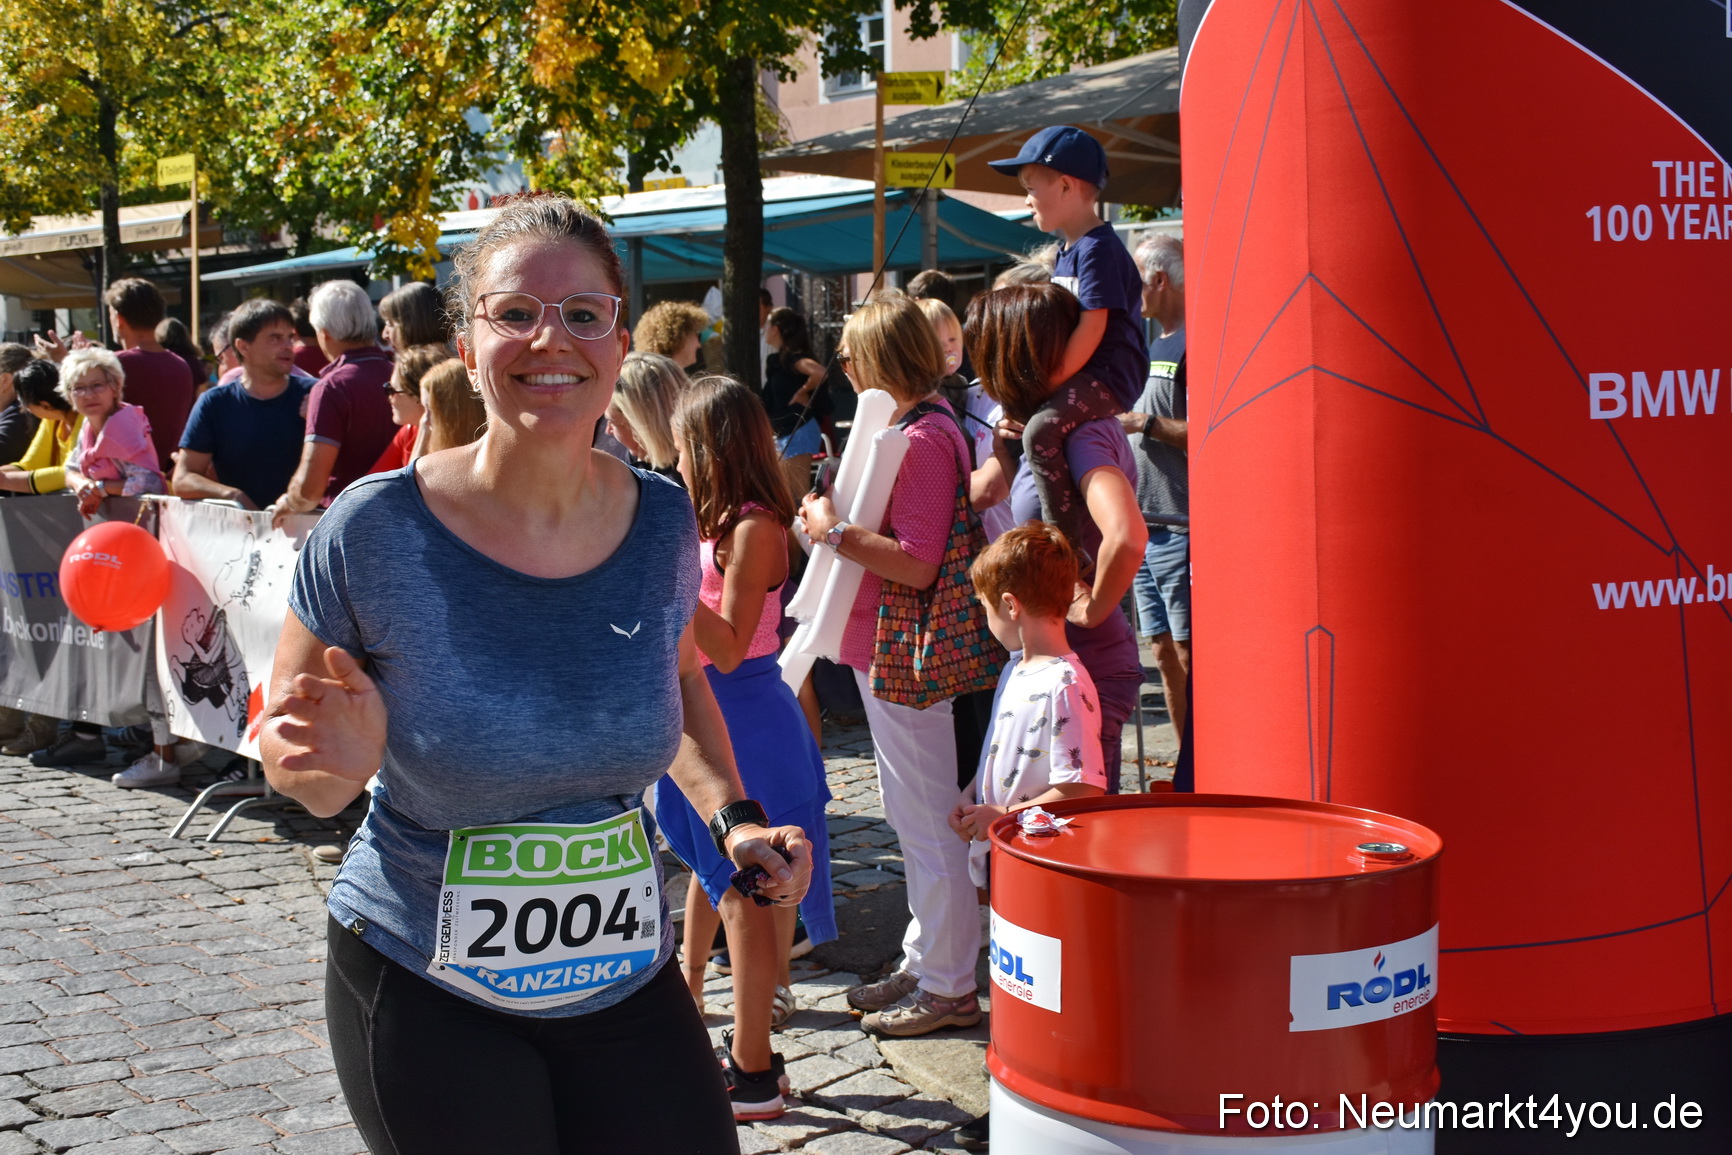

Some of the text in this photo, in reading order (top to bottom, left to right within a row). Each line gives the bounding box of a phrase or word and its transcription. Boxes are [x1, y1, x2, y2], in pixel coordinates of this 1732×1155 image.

[1652, 161, 1716, 198] THE
[1585, 204, 1653, 242] 100
[1589, 368, 1721, 420] BMW
[1592, 564, 1732, 610] www.b
[466, 825, 639, 875] BOCK
[645, 886, 652, 897] D
[467, 887, 640, 958] 2004
